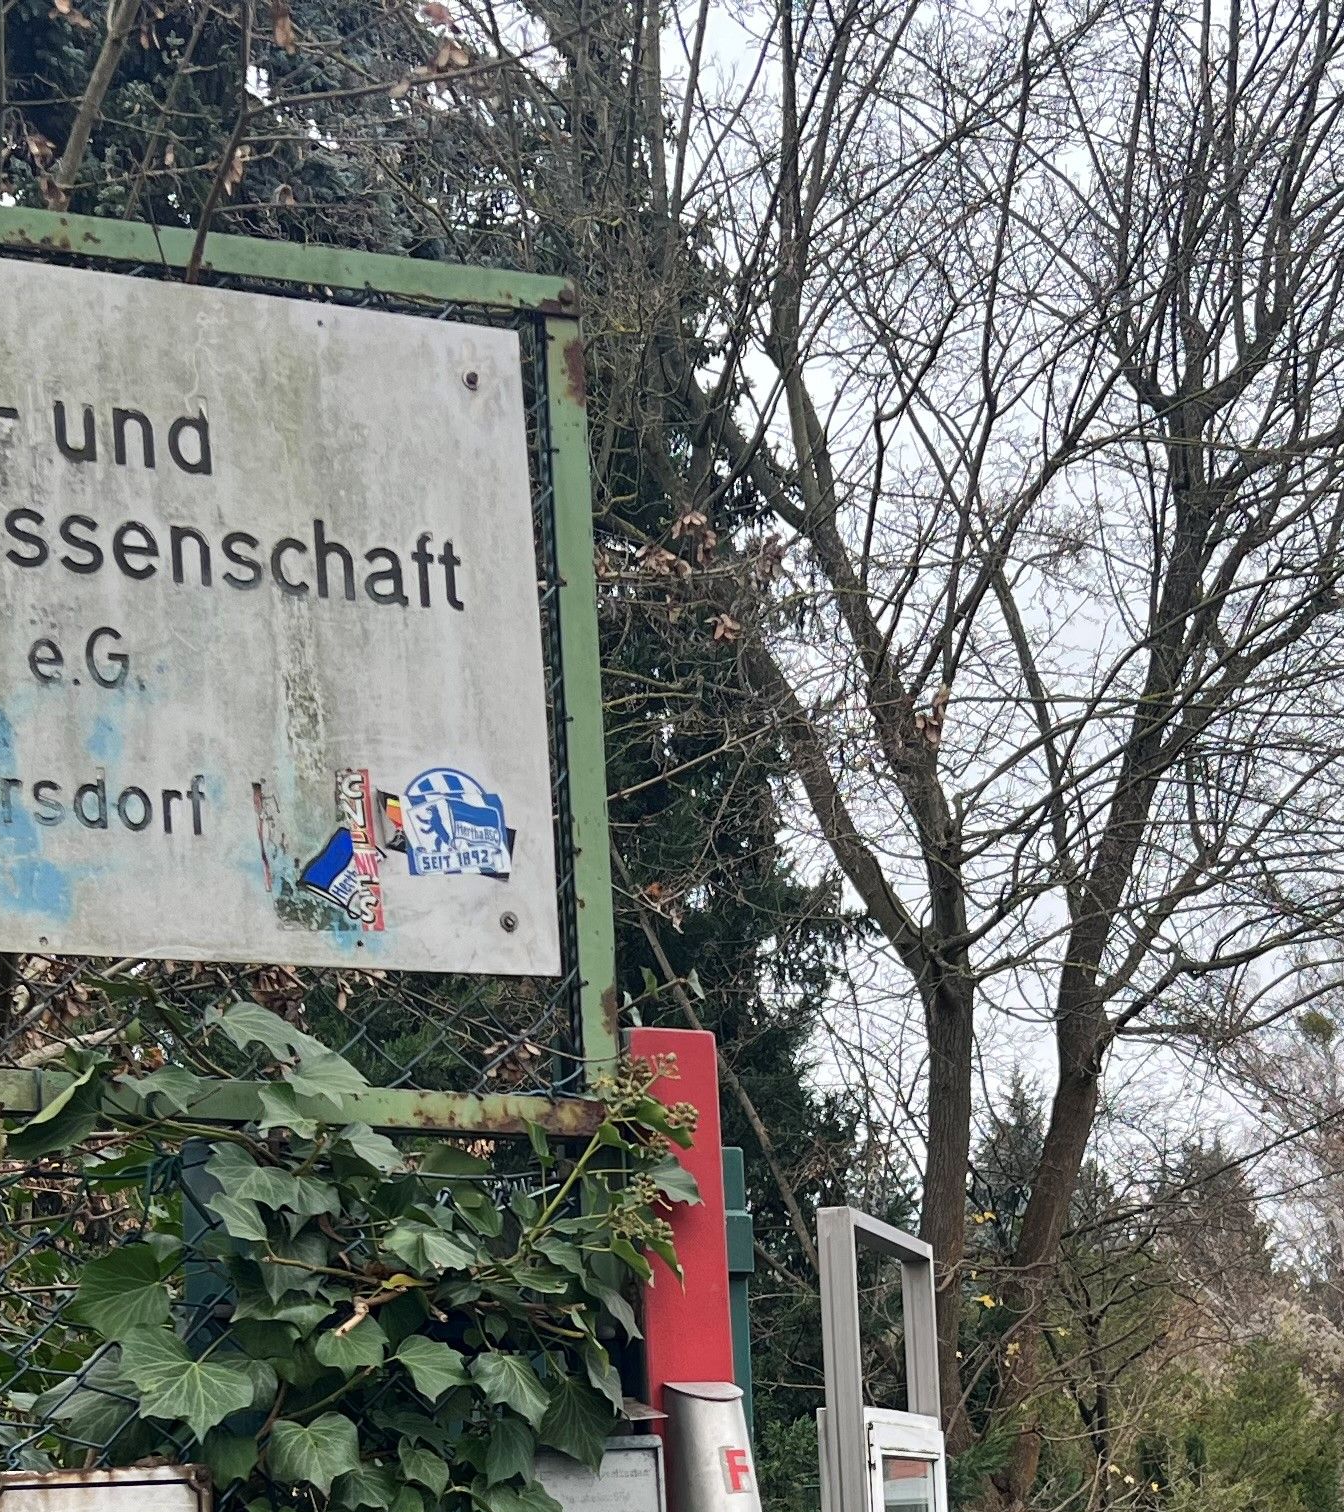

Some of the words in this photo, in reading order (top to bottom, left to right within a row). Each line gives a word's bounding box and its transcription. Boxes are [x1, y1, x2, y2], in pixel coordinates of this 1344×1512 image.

[54, 396, 213, 476] und
[421, 854, 450, 871] SEIT
[457, 849, 489, 867] 1892
[724, 1449, 750, 1491] F
